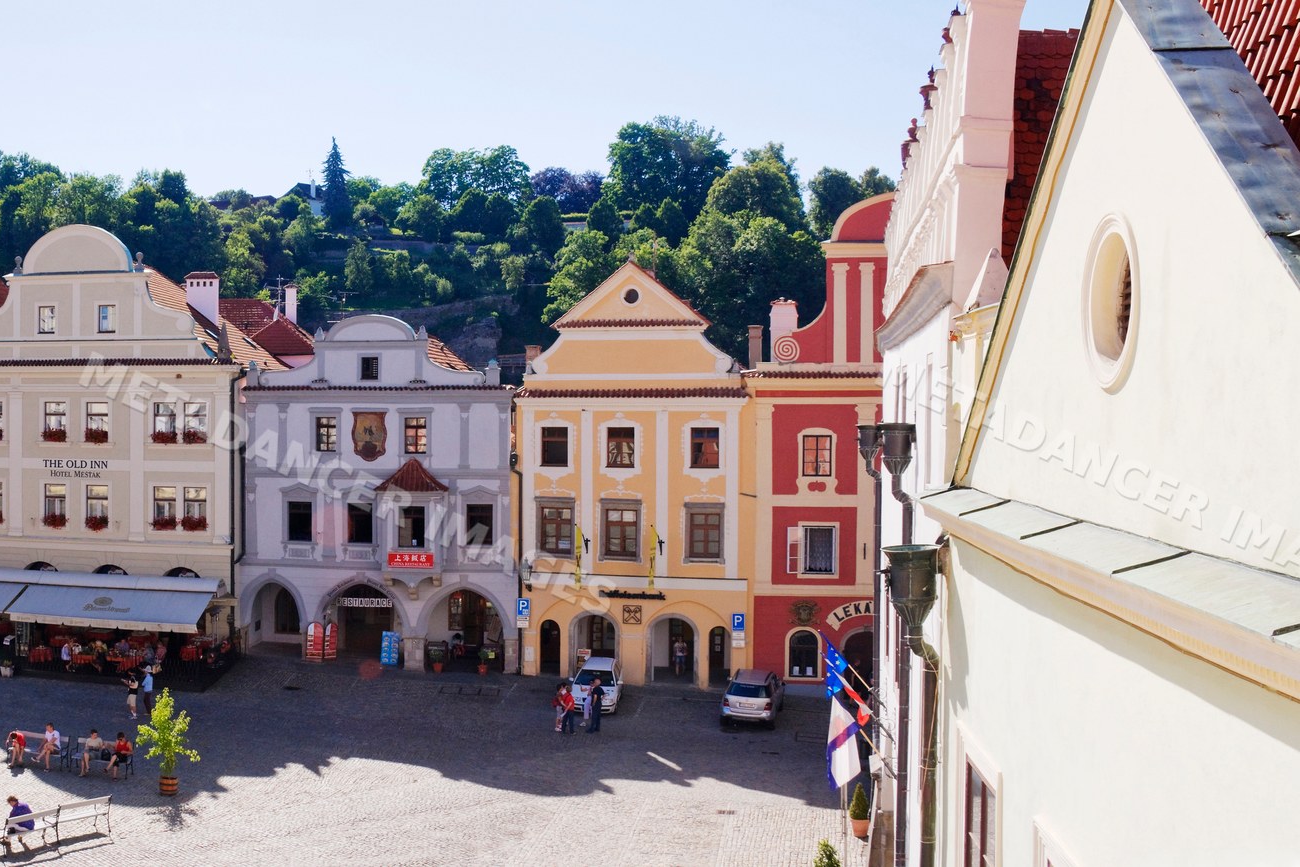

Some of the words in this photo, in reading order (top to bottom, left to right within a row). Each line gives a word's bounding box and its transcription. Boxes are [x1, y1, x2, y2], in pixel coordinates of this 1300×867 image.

[43, 459, 63, 468] THE
[66, 460, 87, 469] OLD
[90, 460, 108, 470] INN
[50, 470, 72, 478] HOTEL
[337, 598, 393, 607] RESTAURACE
[520, 601, 528, 610] P
[734, 615, 743, 627] P
